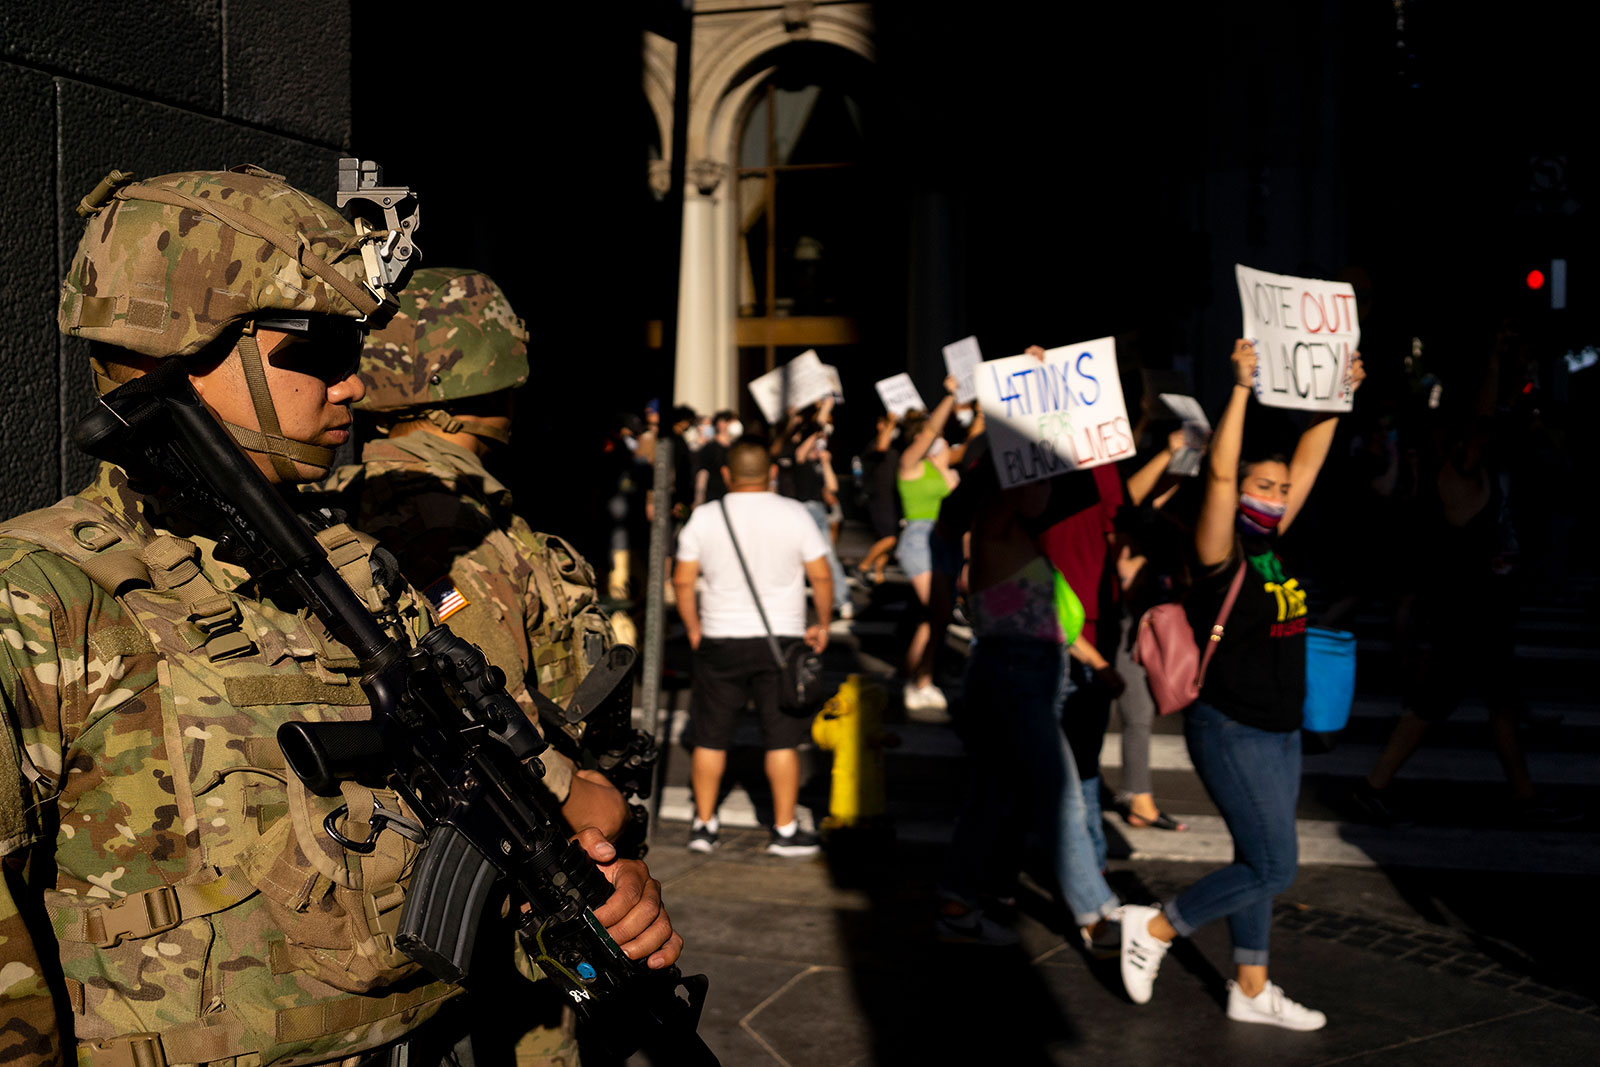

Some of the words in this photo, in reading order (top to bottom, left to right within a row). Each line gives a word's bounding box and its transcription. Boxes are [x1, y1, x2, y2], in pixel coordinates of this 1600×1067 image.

[1301, 291, 1355, 333] OUT
[991, 352, 1101, 418] LATINXS
[1004, 438, 1071, 484] BLACK
[1068, 416, 1132, 465] LIVES
[1037, 411, 1076, 439] FOR
